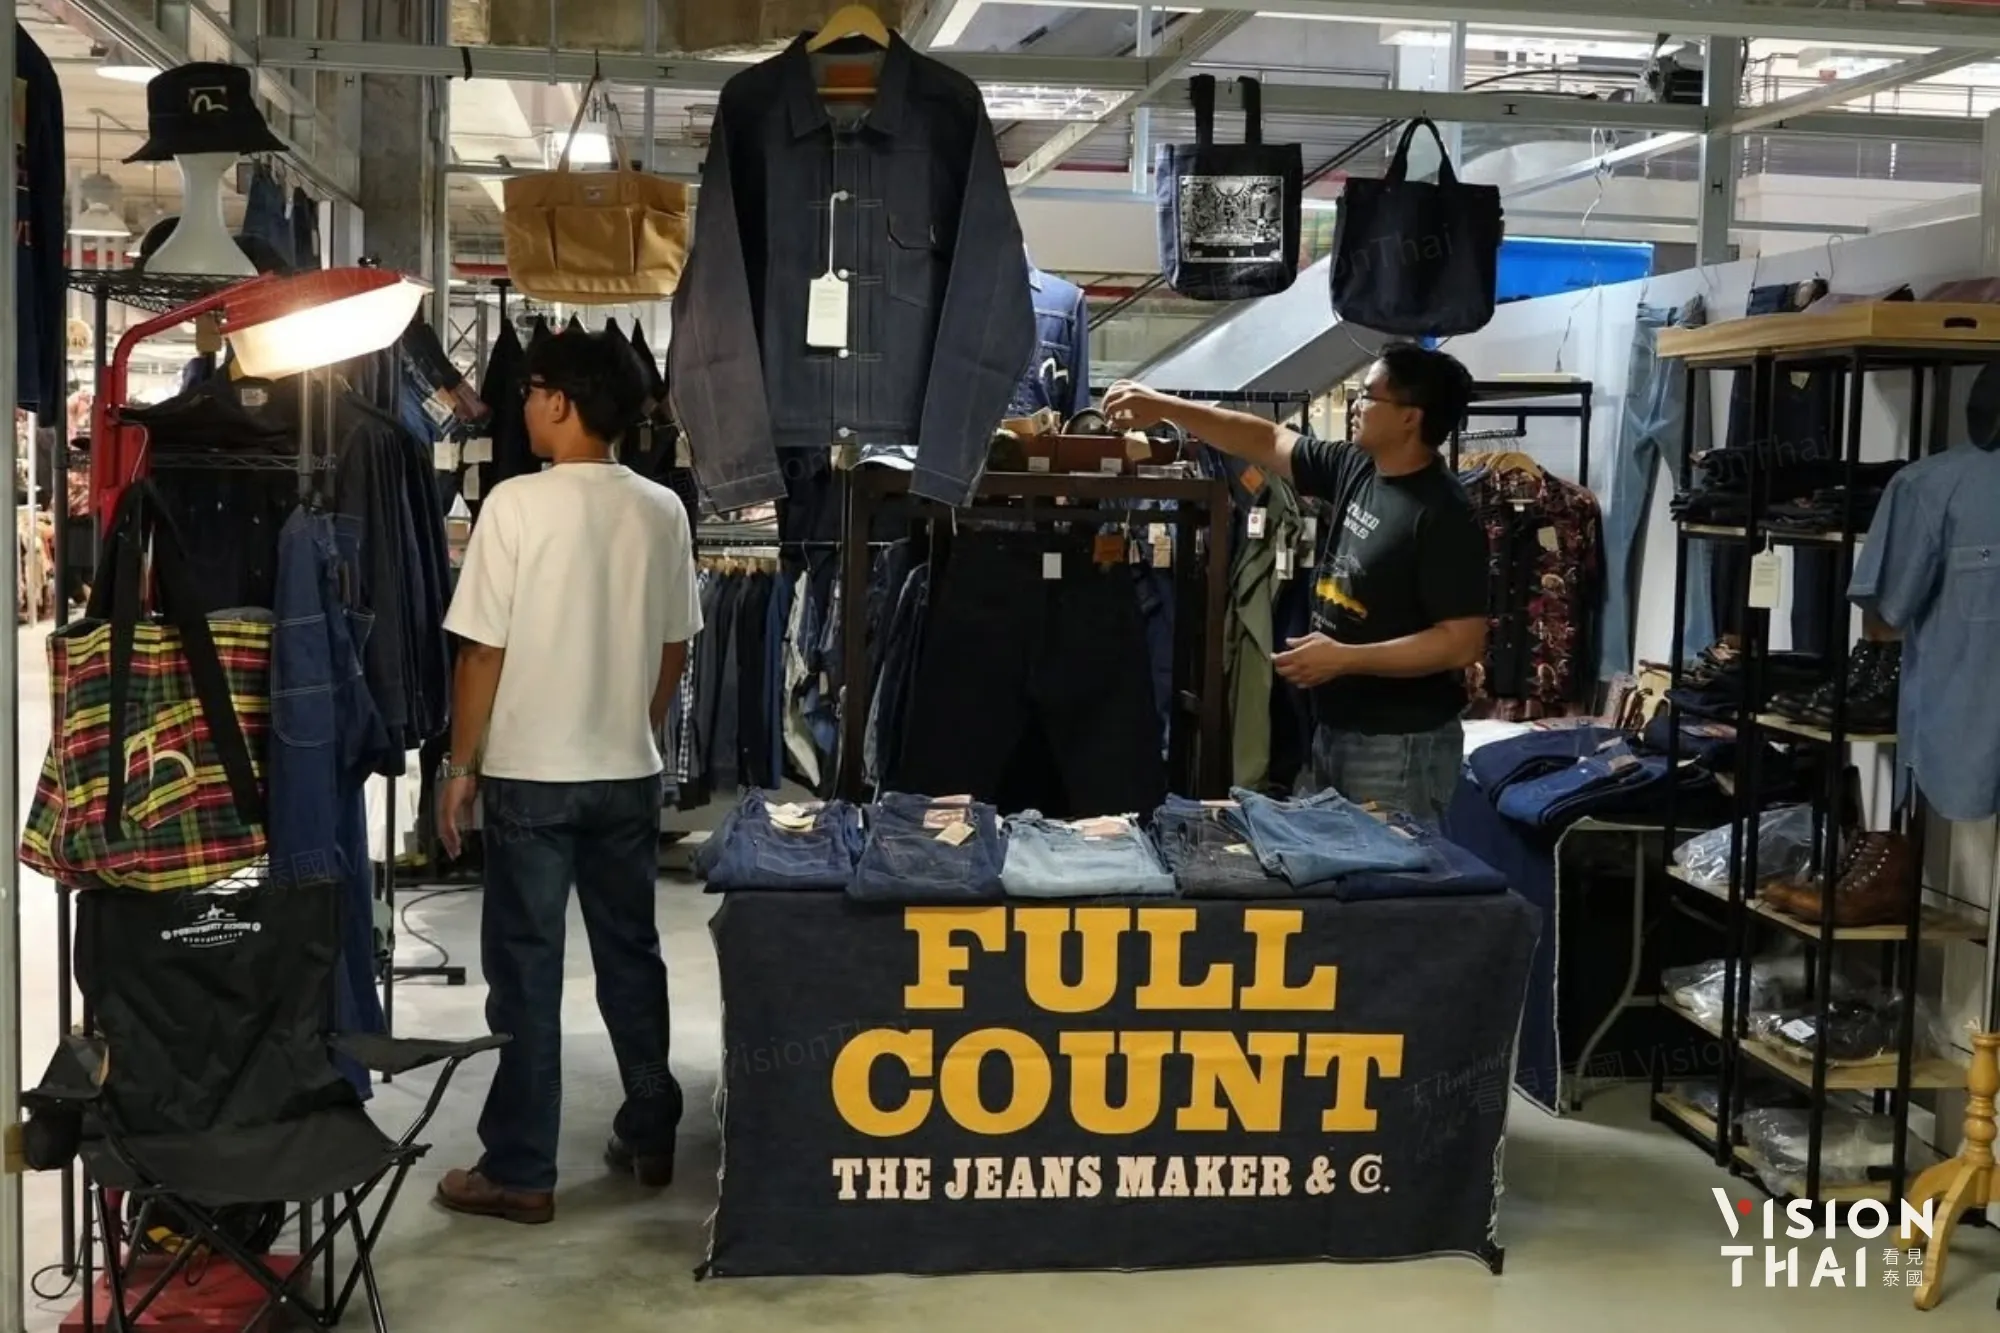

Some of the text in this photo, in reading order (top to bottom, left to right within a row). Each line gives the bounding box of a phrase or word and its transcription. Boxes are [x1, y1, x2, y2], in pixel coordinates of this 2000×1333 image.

[904, 906, 1338, 1013] FULL
[832, 1027, 1404, 1136] COUNT
[832, 1157, 931, 1200] THE
[944, 1156, 1103, 1200] JEANS
[1115, 1155, 1292, 1198] MAKER
[1305, 1155, 1336, 1195] &
